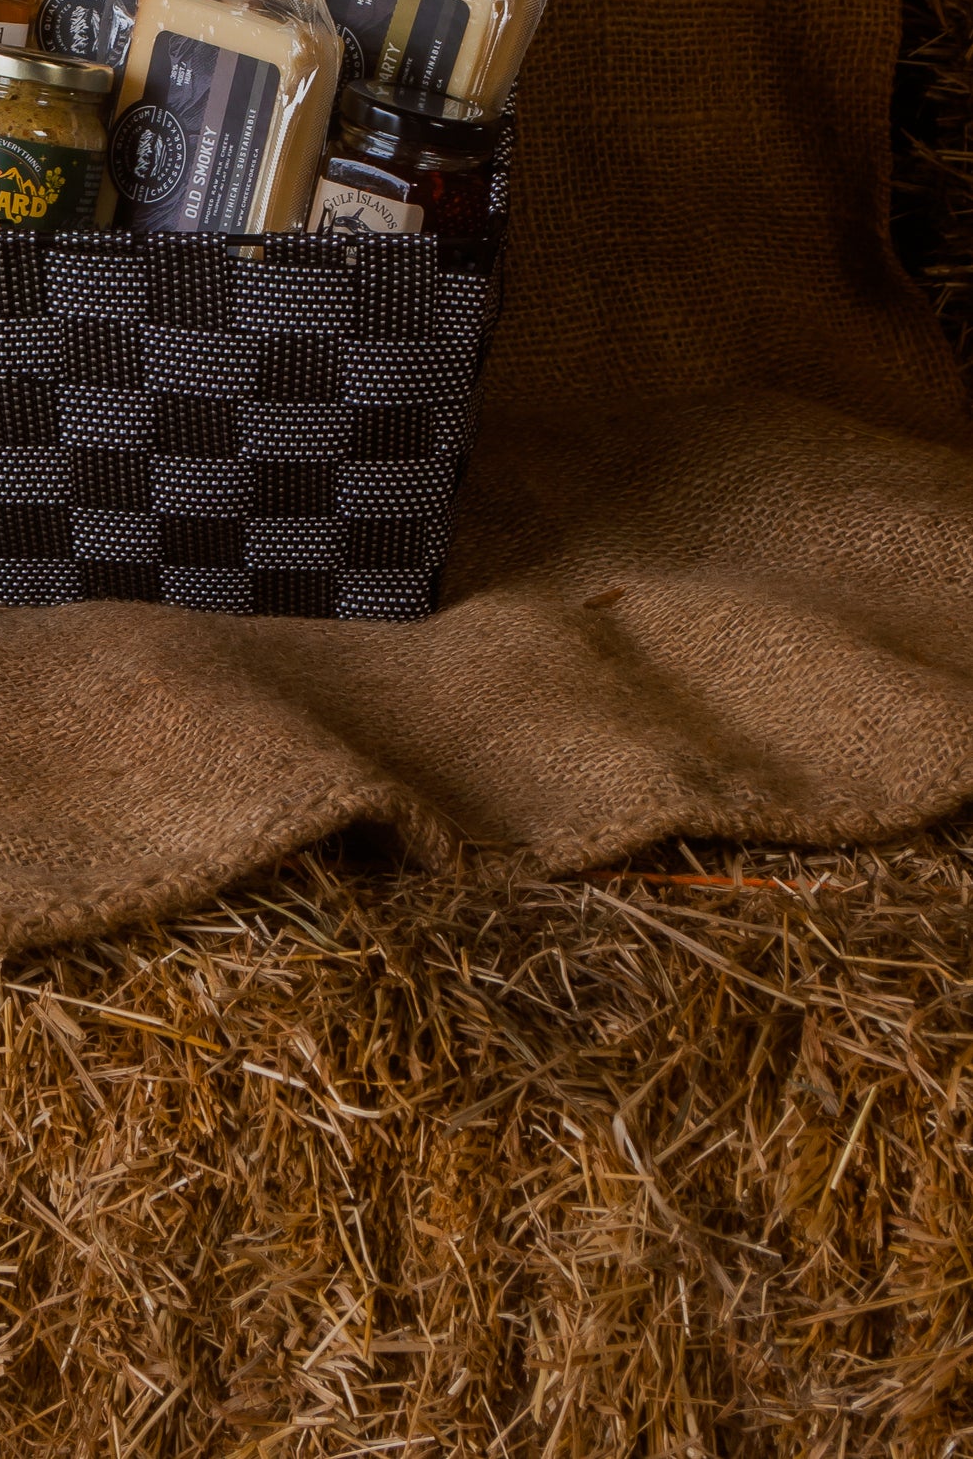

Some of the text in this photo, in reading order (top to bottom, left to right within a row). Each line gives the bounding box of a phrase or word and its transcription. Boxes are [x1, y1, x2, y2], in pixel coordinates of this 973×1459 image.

[379, 42, 402, 83] ARTY
[424, 38, 443, 86] STAINABLE
[117, 109, 151, 150] QUALICUM
[150, 120, 183, 197] CHEESEWORKS
[226, 108, 257, 219] ETHICAL SUSTAINABLE
[184, 125, 217, 219] OLD SMOKEY
[204, 199, 214, 224] SMOKED
[220, 133, 230, 158] CHEESE
[235, 148, 259, 227] WWW.CHEESEWORKS.CA
[323, 190, 398, 230] GULF ISLANDS
